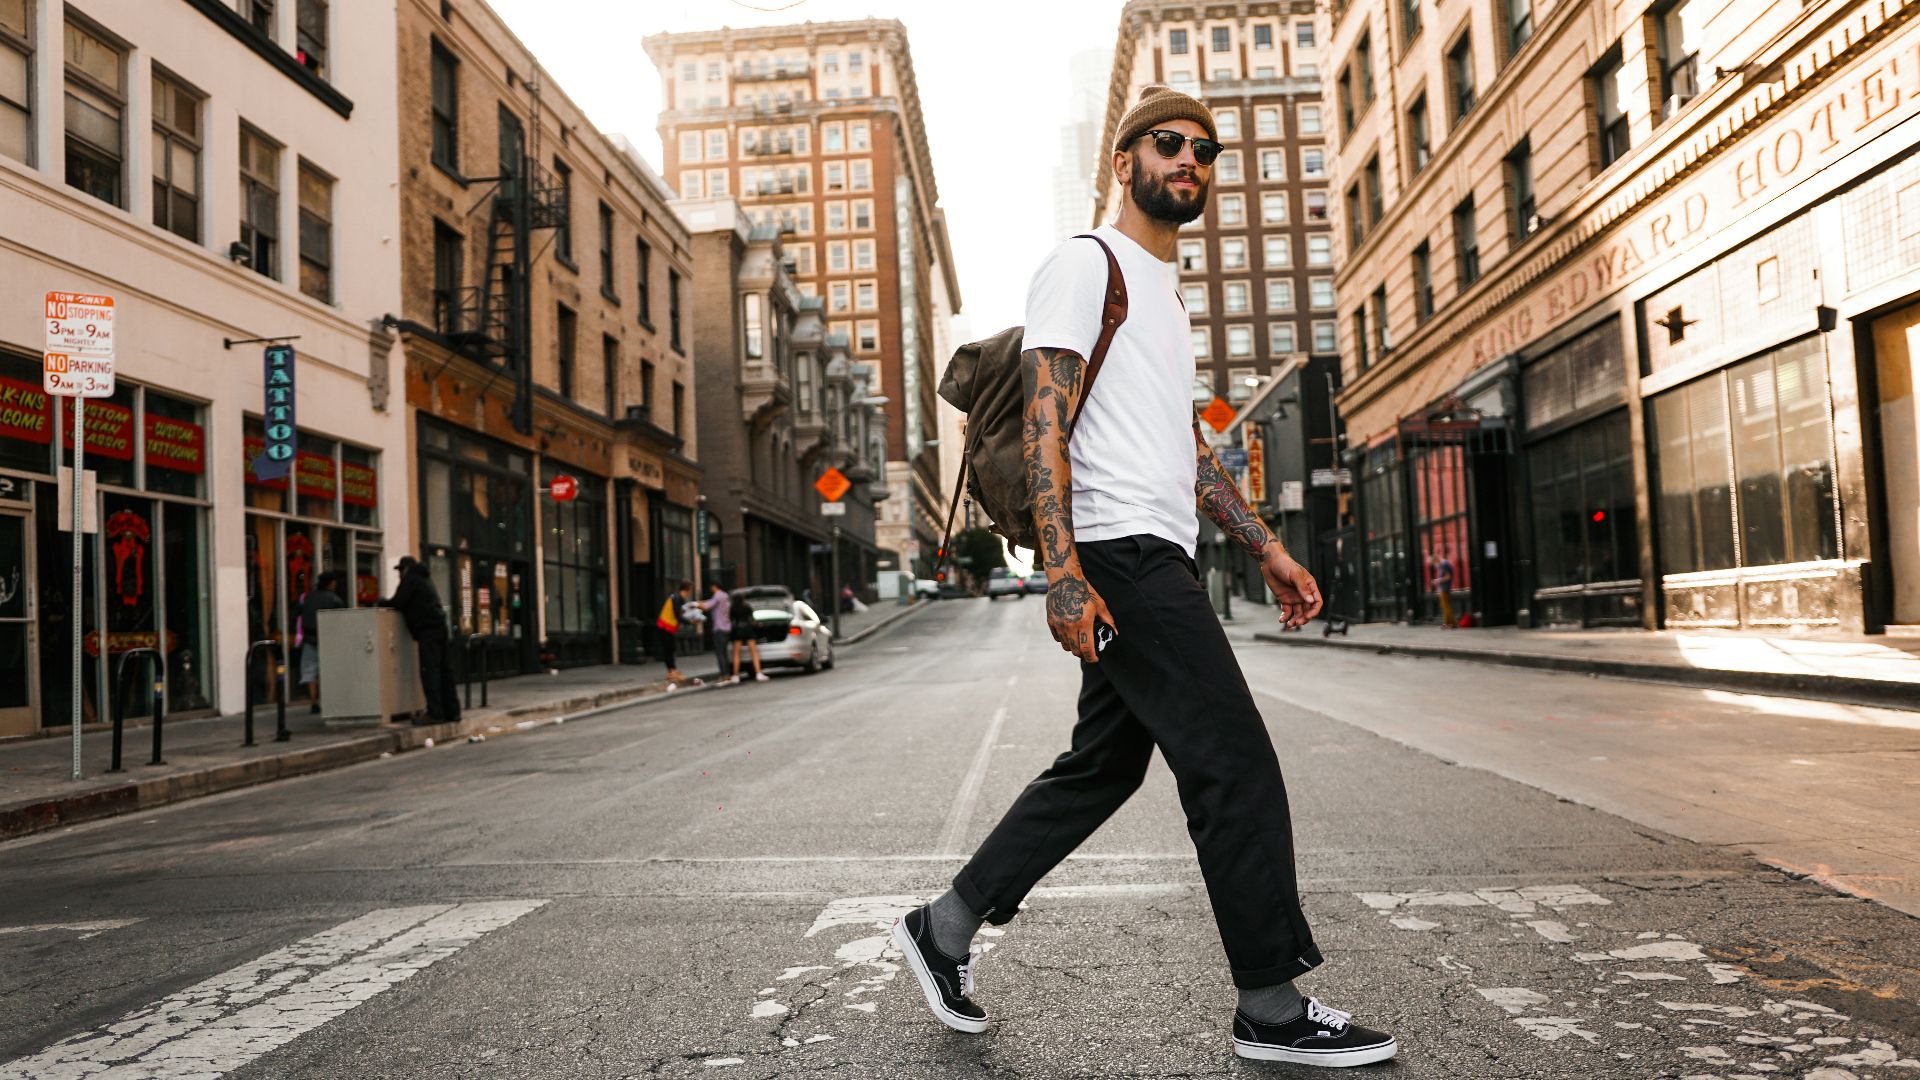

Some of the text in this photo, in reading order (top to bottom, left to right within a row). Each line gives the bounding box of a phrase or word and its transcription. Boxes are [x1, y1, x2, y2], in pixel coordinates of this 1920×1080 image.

[1472, 305, 1533, 369] KING
[1546, 192, 1708, 323] EDWARD
[48, 301, 112, 321] NO STOPPING
[50, 320, 75, 336] 3PM
[86, 324, 110, 339] 9AM
[64, 337, 96, 346] NIGHTLY
[47, 354, 111, 374] NO PARKING
[50, 374, 74, 389] 9AM
[86, 377, 109, 391] 3PM
[267, 349, 293, 460] TATTOO
